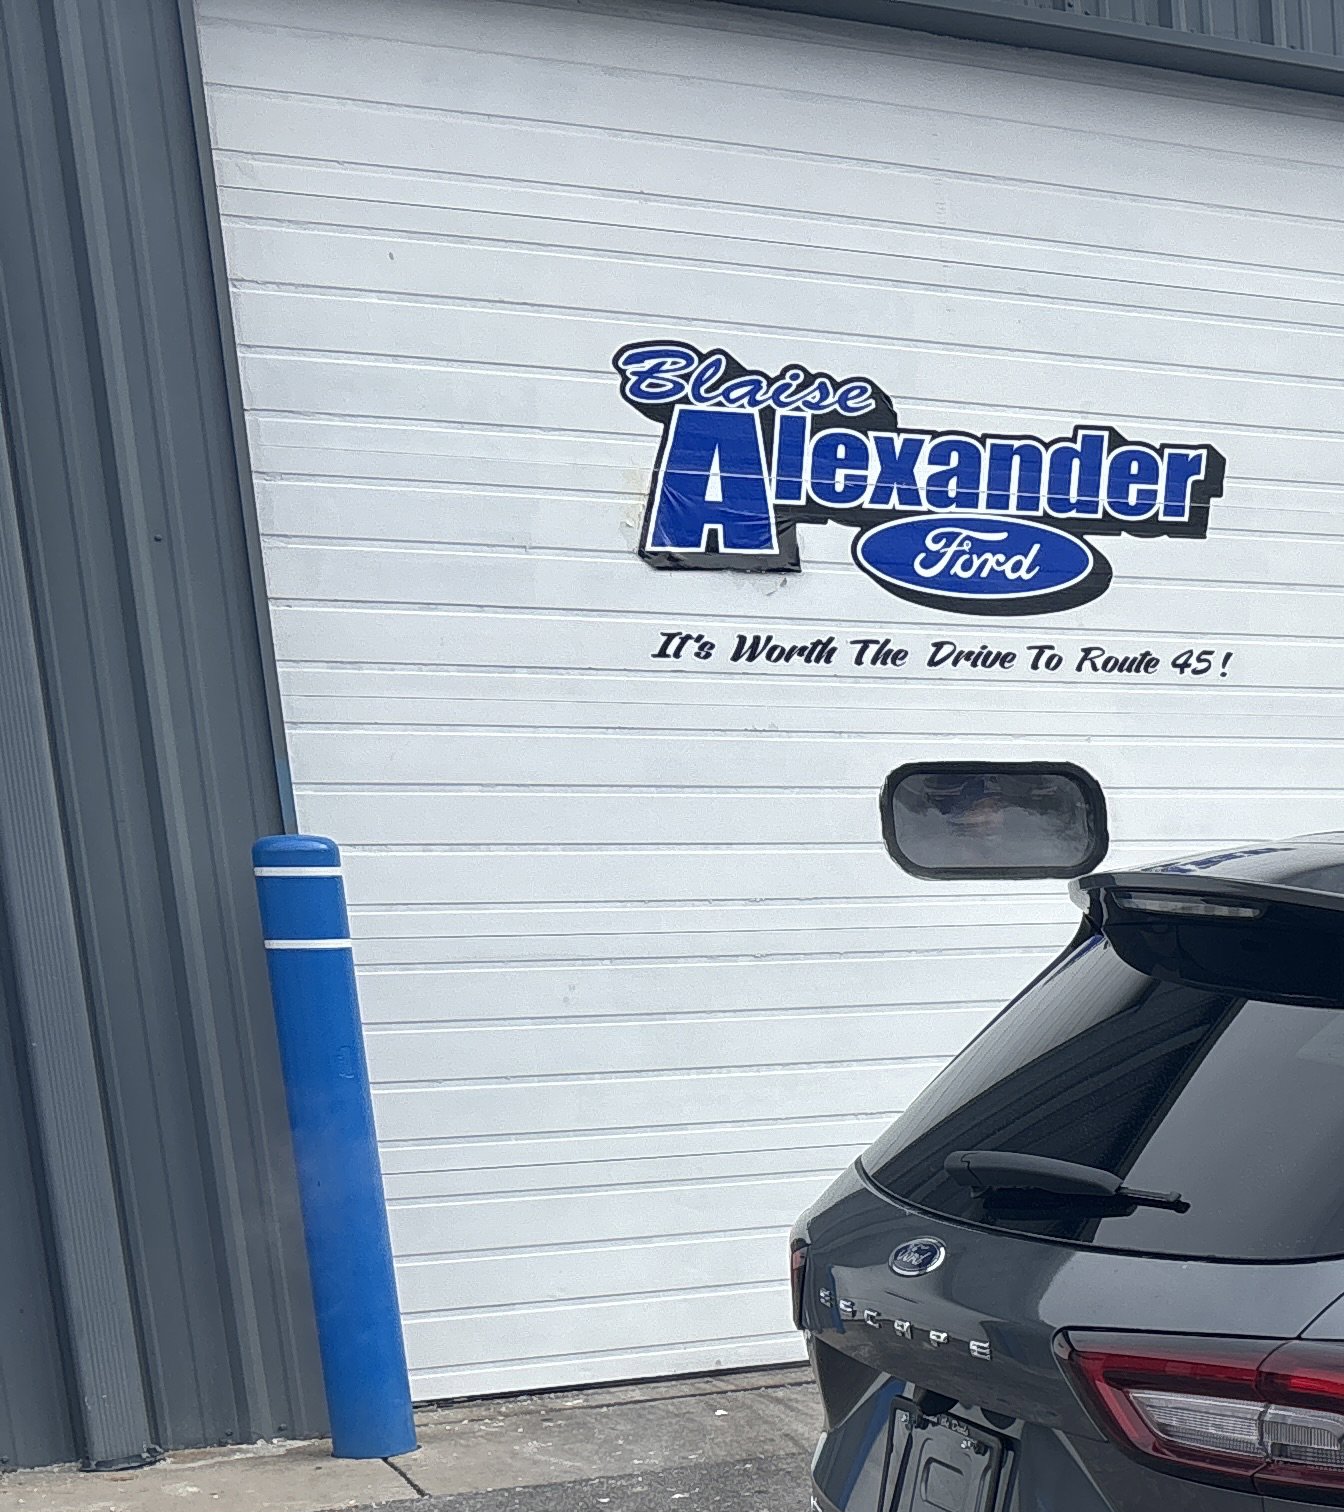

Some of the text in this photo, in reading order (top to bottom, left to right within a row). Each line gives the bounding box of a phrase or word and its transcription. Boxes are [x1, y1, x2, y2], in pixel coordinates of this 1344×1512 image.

[615, 344, 876, 418] Blaise
[645, 405, 1206, 555] Alexander
[913, 526, 1040, 582] Ford
[650, 631, 715, 661] It's
[730, 635, 837, 667] Worth
[850, 639, 909, 667] The
[926, 641, 1017, 671] Drive
[1027, 645, 1063, 673] To
[1076, 646, 1161, 676] Route
[896, 1242, 931, 1265] Ford
